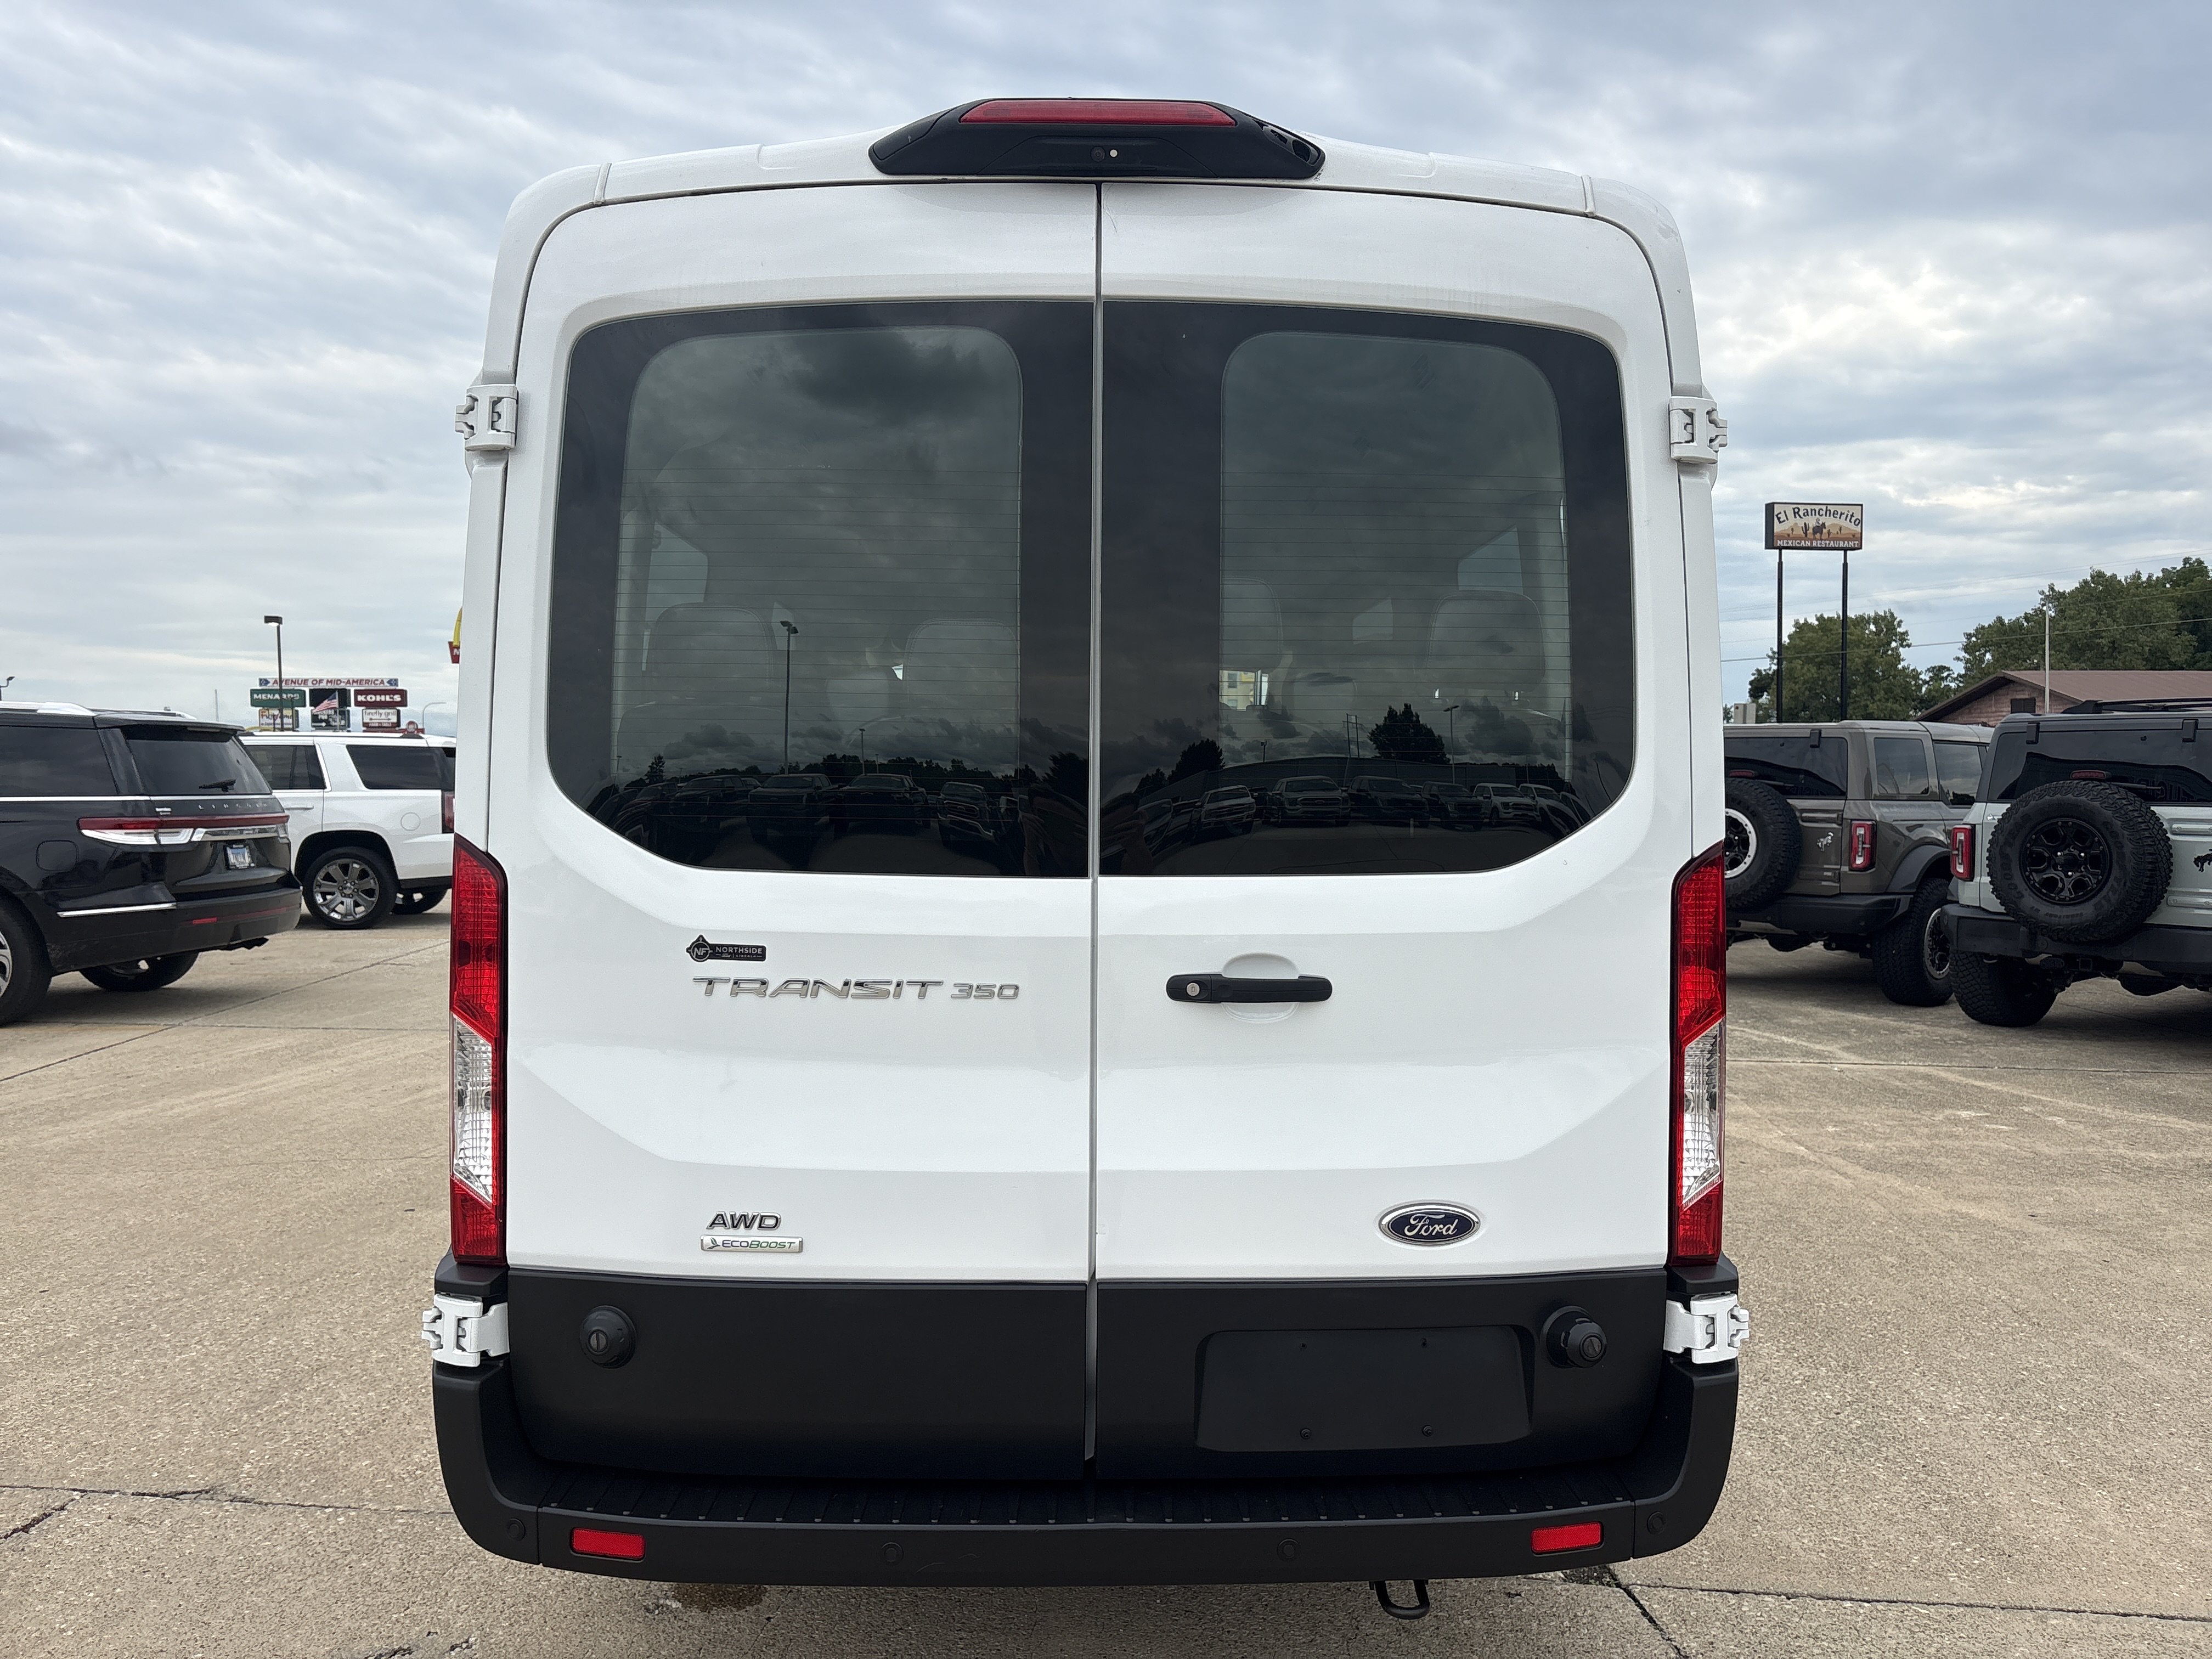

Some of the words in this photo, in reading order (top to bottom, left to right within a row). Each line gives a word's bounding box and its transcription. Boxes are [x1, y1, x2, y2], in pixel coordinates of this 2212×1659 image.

[1775, 510, 1789, 524] El
[1792, 506, 1861, 527] Rancherito
[715, 946, 763, 954] NORTHSIDE
[693, 977, 944, 998] TRANSIT
[951, 982, 1019, 999] 350
[706, 1211, 781, 1231] AWD
[1404, 1214, 1459, 1236] Ford
[722, 1239, 795, 1249] ECOBOOST
